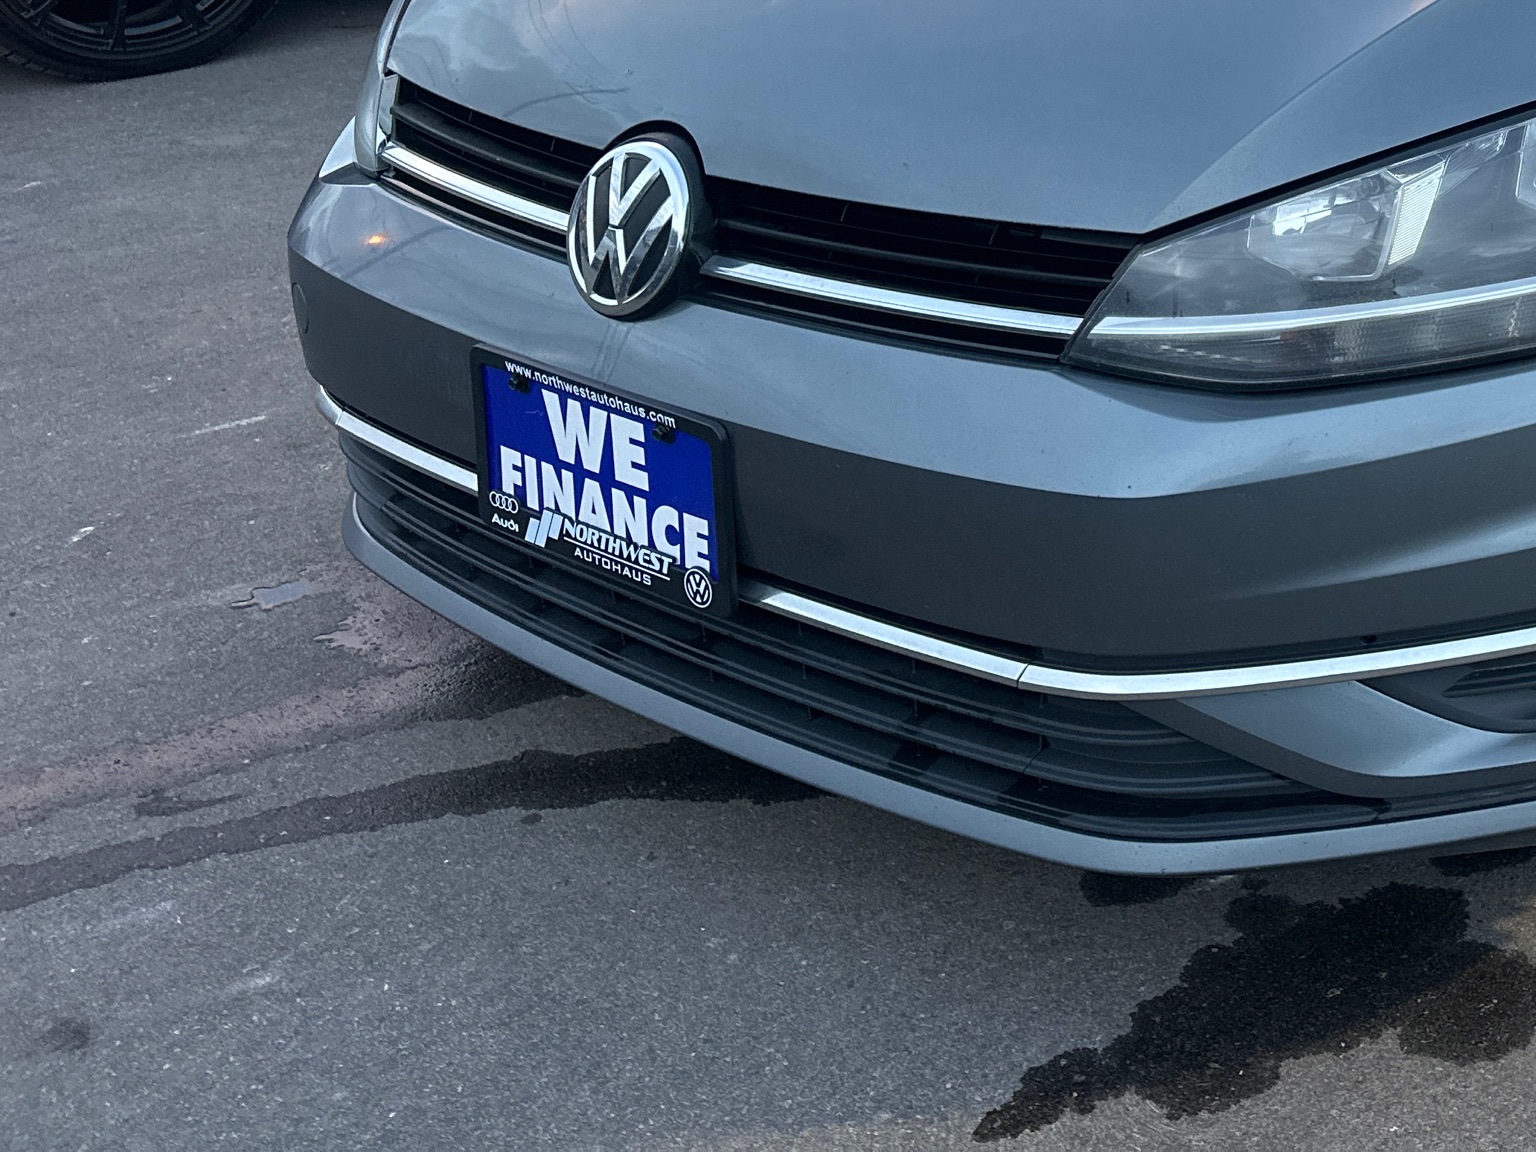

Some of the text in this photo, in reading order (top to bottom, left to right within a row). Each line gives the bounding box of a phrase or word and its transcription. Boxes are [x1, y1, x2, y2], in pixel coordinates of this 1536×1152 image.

[505, 360, 677, 429] www.northwestautohaus.com
[541, 389, 650, 492] WE
[491, 513, 520, 533] Audi
[500, 444, 712, 573] FINANCE
[562, 518, 673, 575] NORTHWEST
[574, 547, 653, 586] AUTOHAUS
